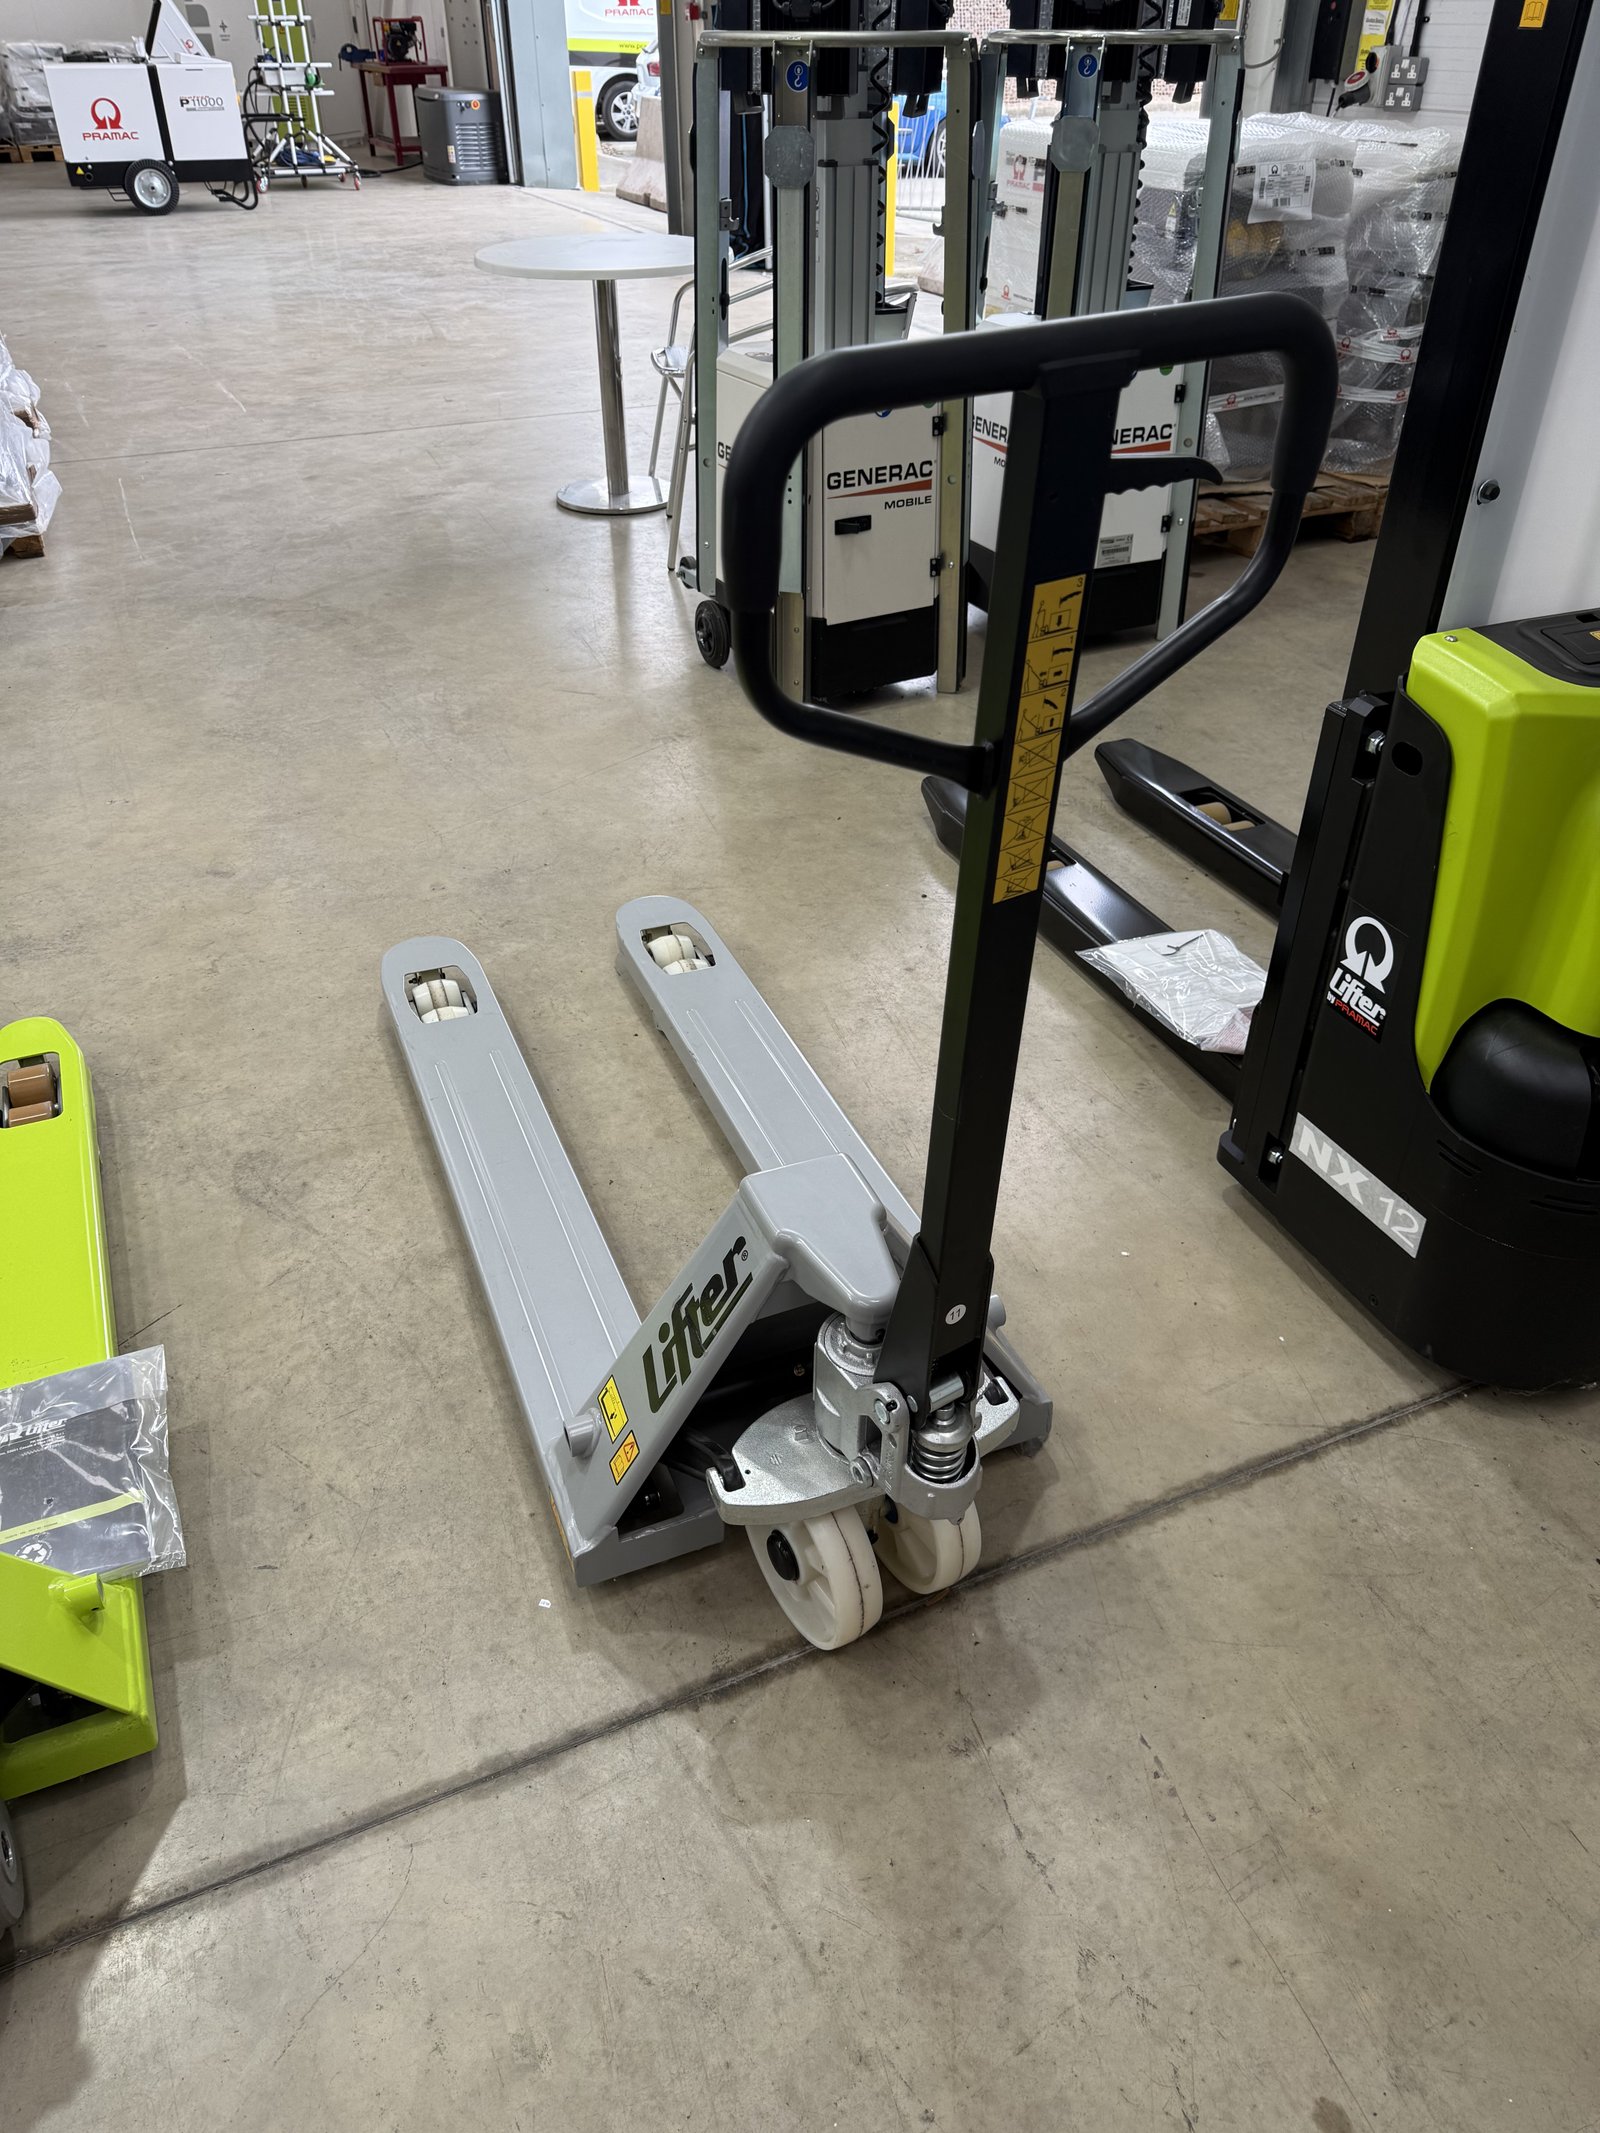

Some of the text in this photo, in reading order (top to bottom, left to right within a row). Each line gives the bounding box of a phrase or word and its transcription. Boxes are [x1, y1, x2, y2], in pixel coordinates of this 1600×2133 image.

[604, 7, 654, 17] PRAMAC
[82, 131, 139, 141] PRAMAC
[973, 415, 1008, 443] ENER
[826, 460, 933, 491] GENERAC
[884, 495, 932, 510] MOBILE
[1329, 967, 1387, 1027] Lifter
[1334, 999, 1378, 1036] PRAMAC
[1298, 1124, 1420, 1248] NX 12
[642, 1236, 754, 1414] Lifter
[950, 1308, 961, 1321] 11
